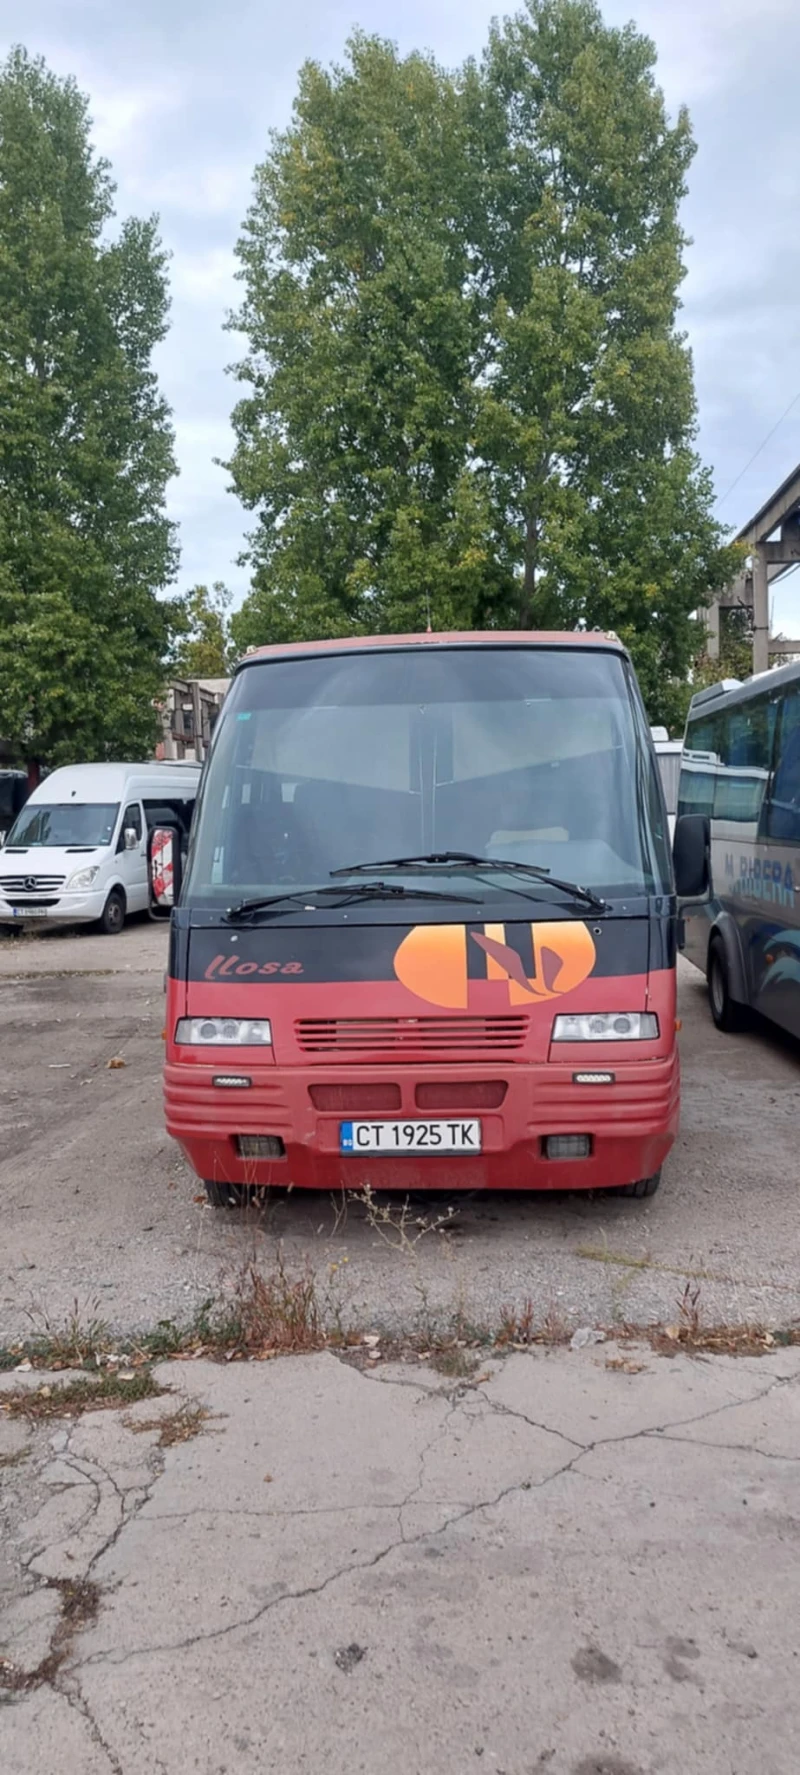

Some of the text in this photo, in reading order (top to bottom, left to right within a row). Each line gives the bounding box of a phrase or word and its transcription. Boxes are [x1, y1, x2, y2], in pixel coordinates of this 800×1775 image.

[356, 1123, 474, 1147] CT 1925 TK
